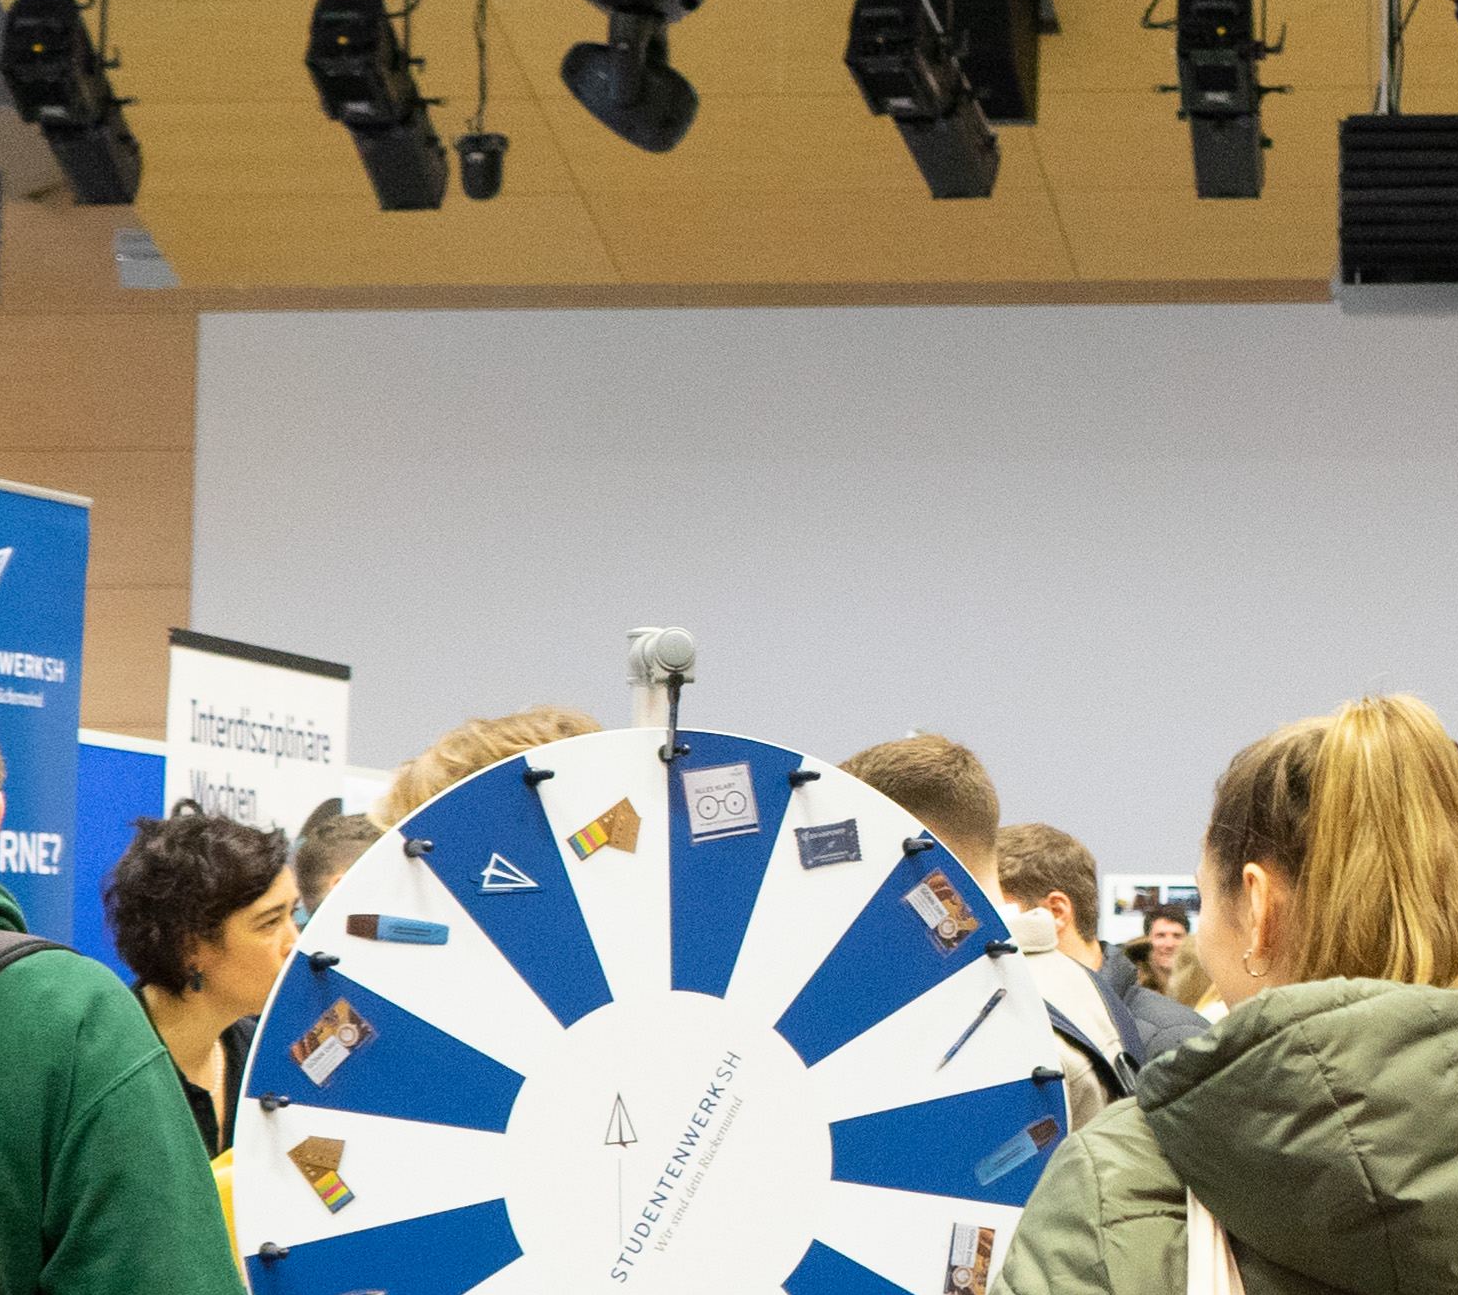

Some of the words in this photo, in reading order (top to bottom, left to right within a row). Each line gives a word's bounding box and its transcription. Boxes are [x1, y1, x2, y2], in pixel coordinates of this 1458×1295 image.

[190, 698, 331, 768] Interdisziplinäre
[610, 1050, 742, 1283] STUDENTENWERKSH
[654, 1225, 674, 1253] Wir
[686, 1167, 705, 1199] dein
